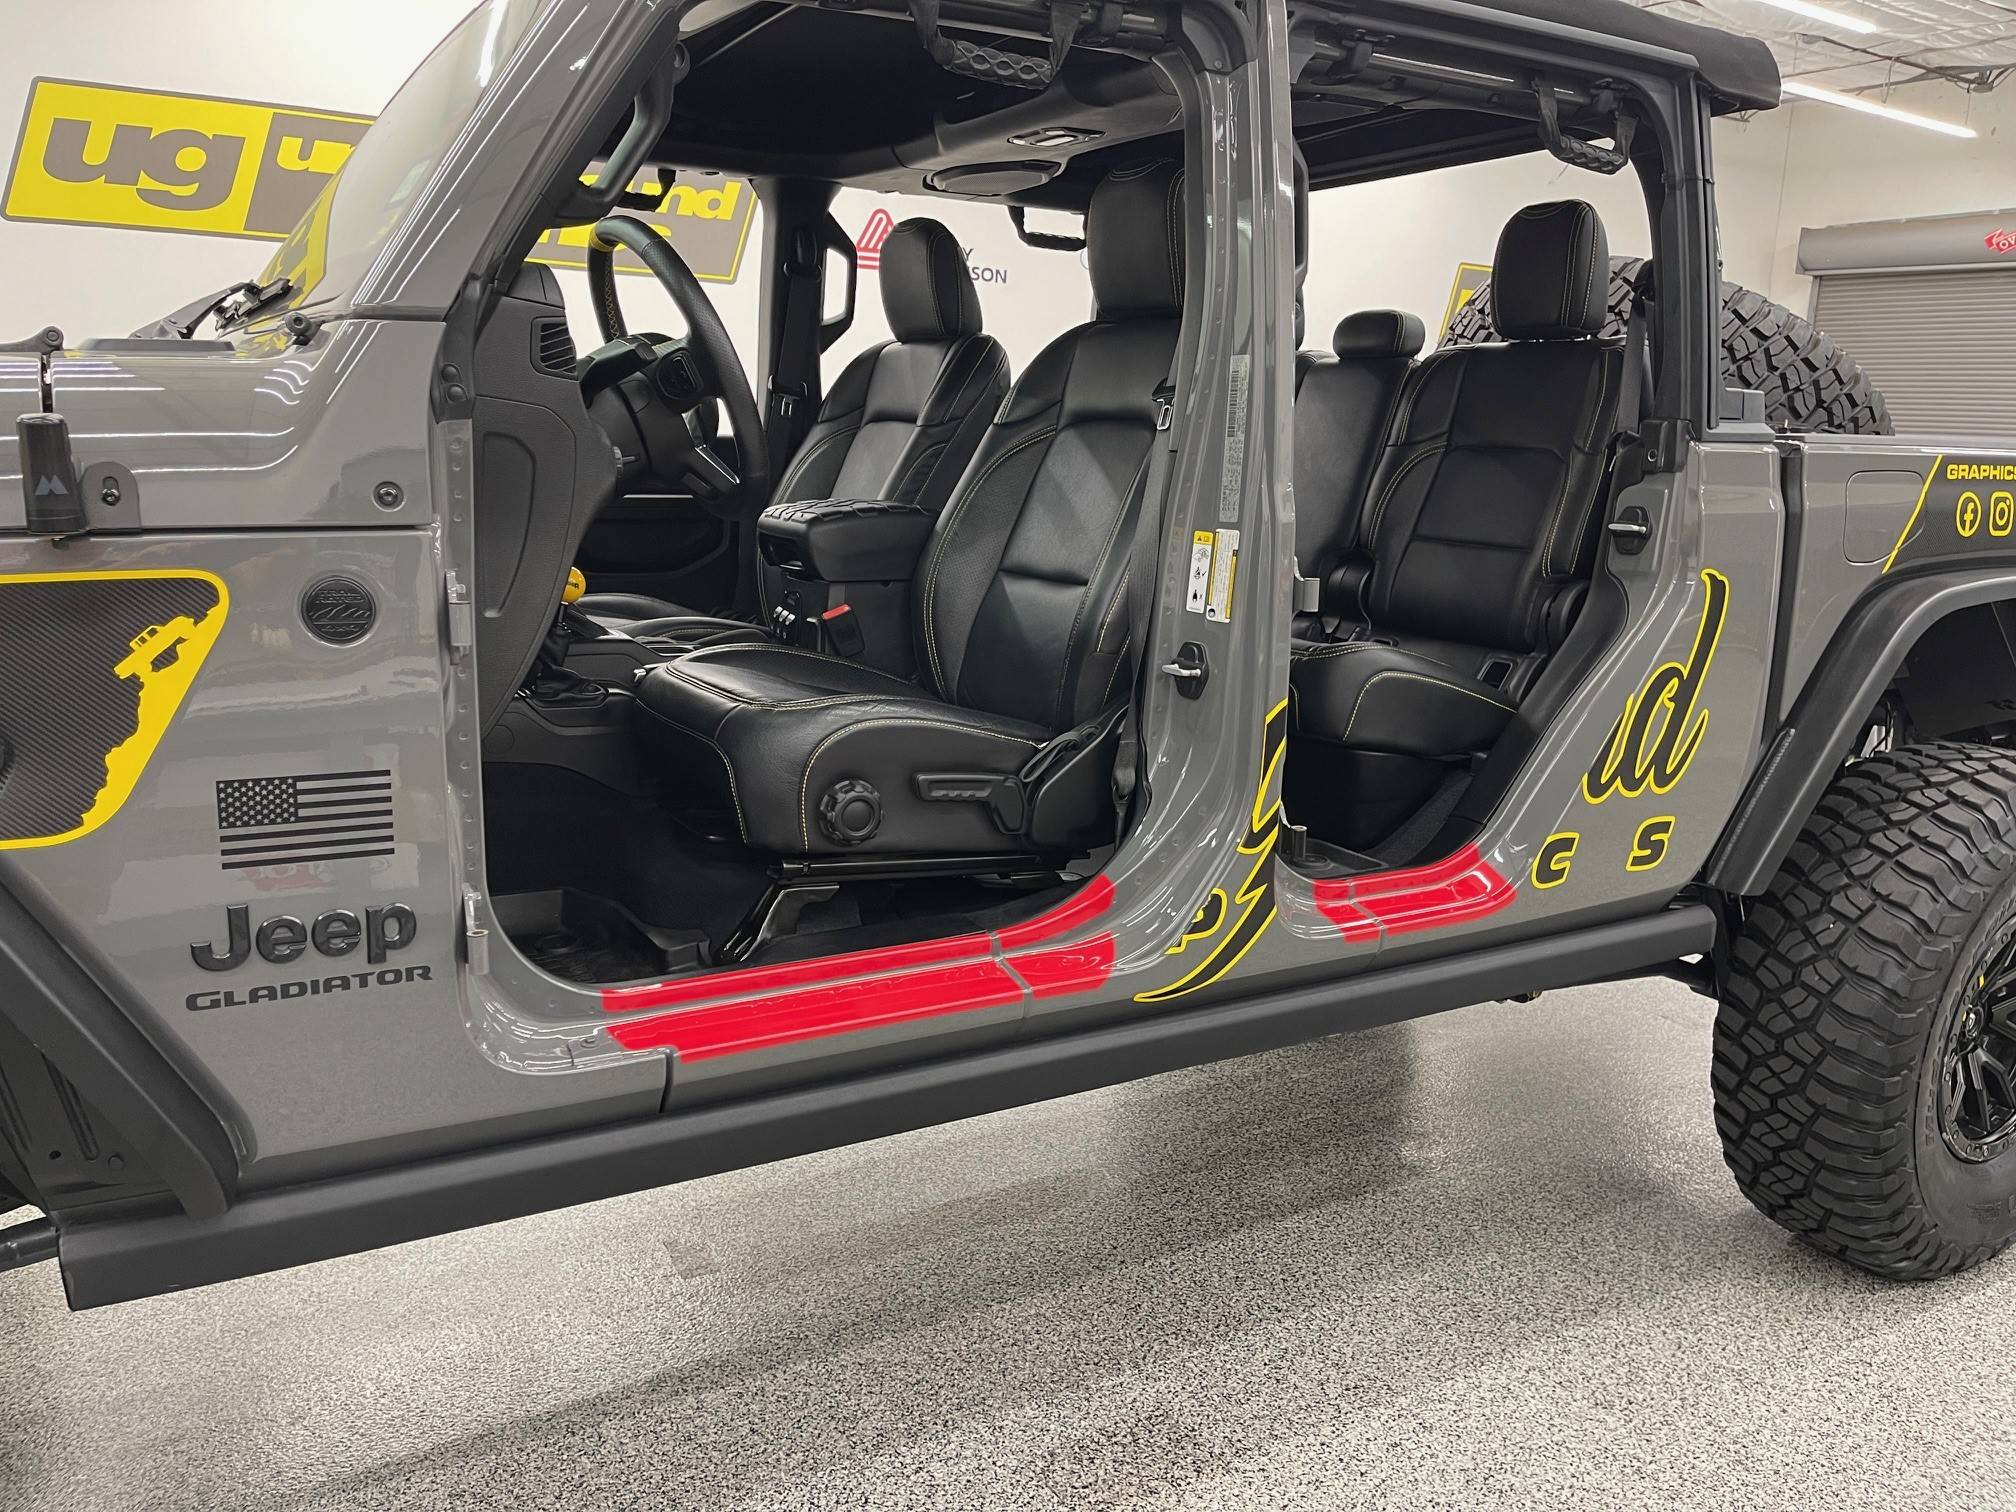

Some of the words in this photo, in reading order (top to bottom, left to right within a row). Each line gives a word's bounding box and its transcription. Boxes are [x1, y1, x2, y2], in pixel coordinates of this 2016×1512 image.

[43, 117, 246, 211] ug
[1946, 463, 2016, 480] GRAPHIC
[190, 903, 417, 972] Jeep
[185, 965, 433, 1012] GLADIATOR
